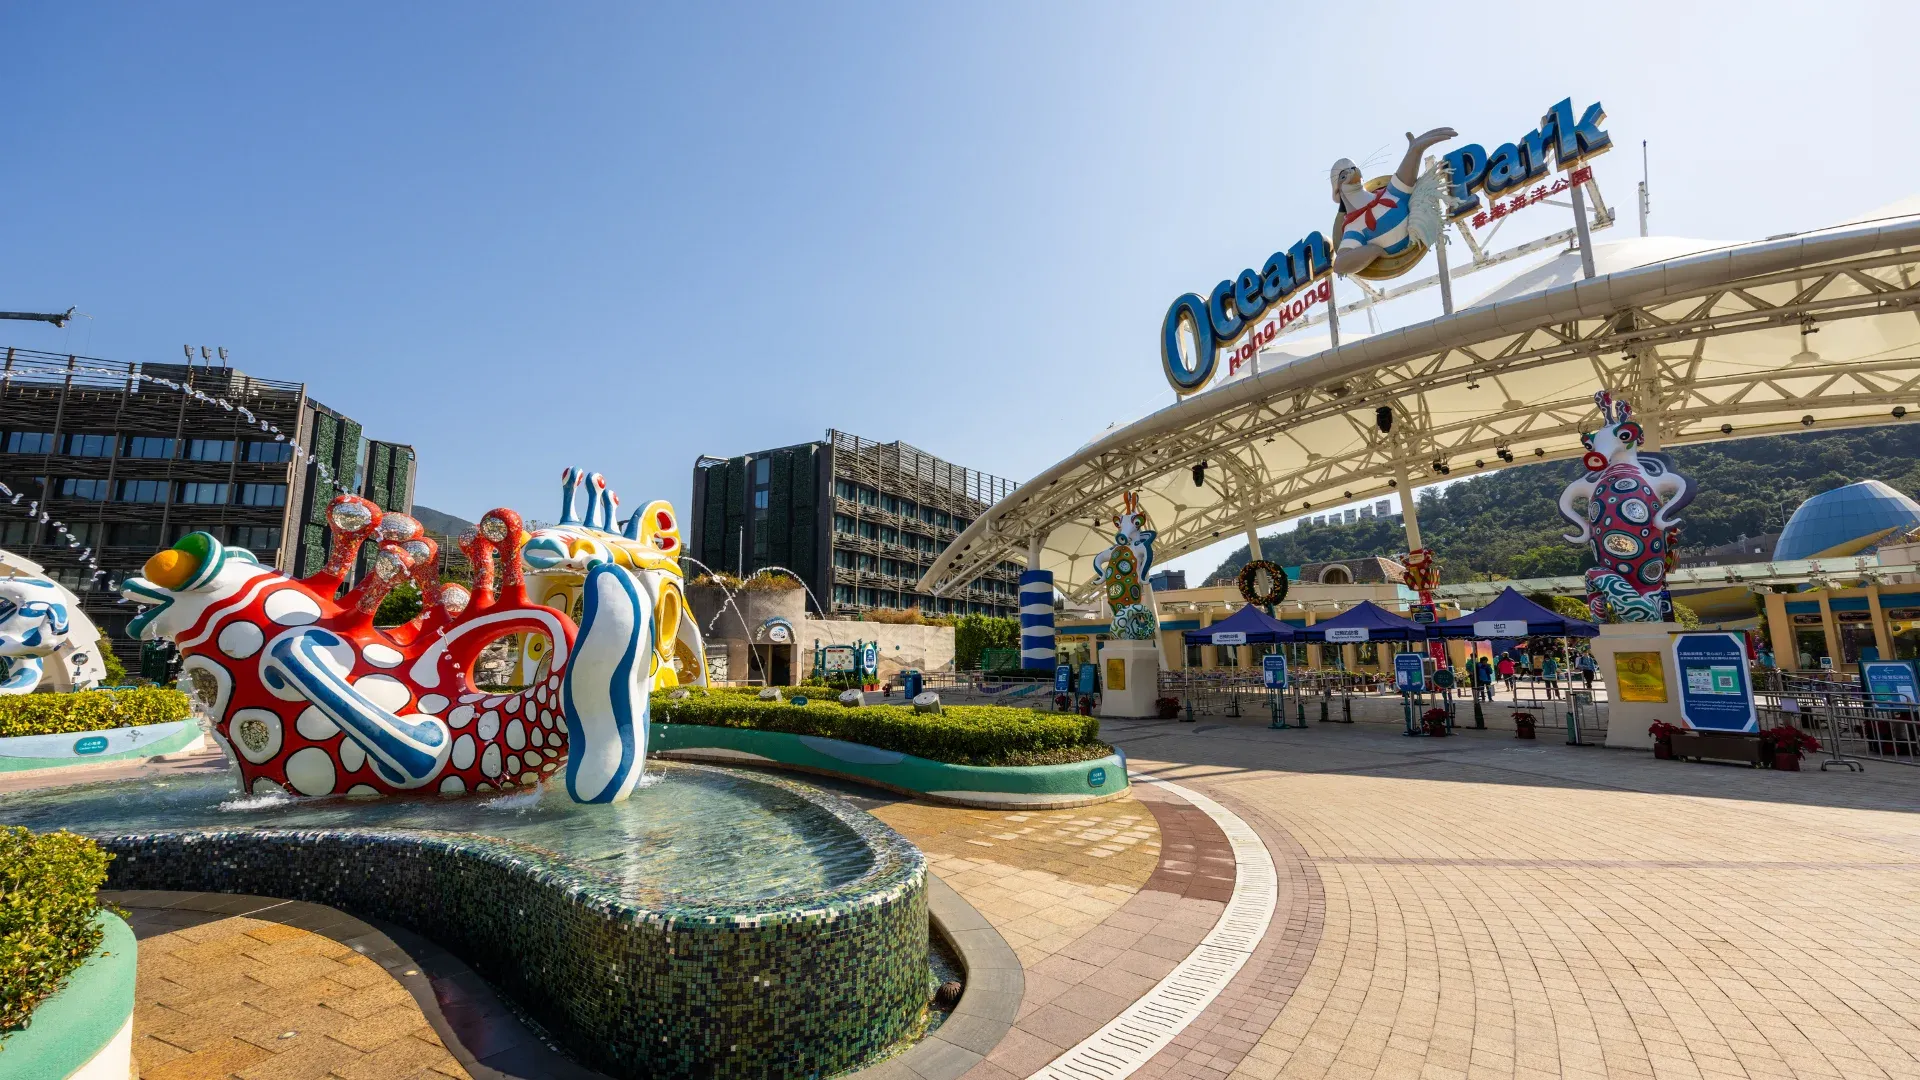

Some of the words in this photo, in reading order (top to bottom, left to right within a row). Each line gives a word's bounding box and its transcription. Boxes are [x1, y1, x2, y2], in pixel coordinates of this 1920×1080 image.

[1161, 231, 1335, 395] Ocean
[1444, 96, 1614, 222] Park
[1472, 165, 1593, 230] 香港海洋公園
[1229, 321, 1276, 377] Hong
[1279, 280, 1332, 330] Kong
